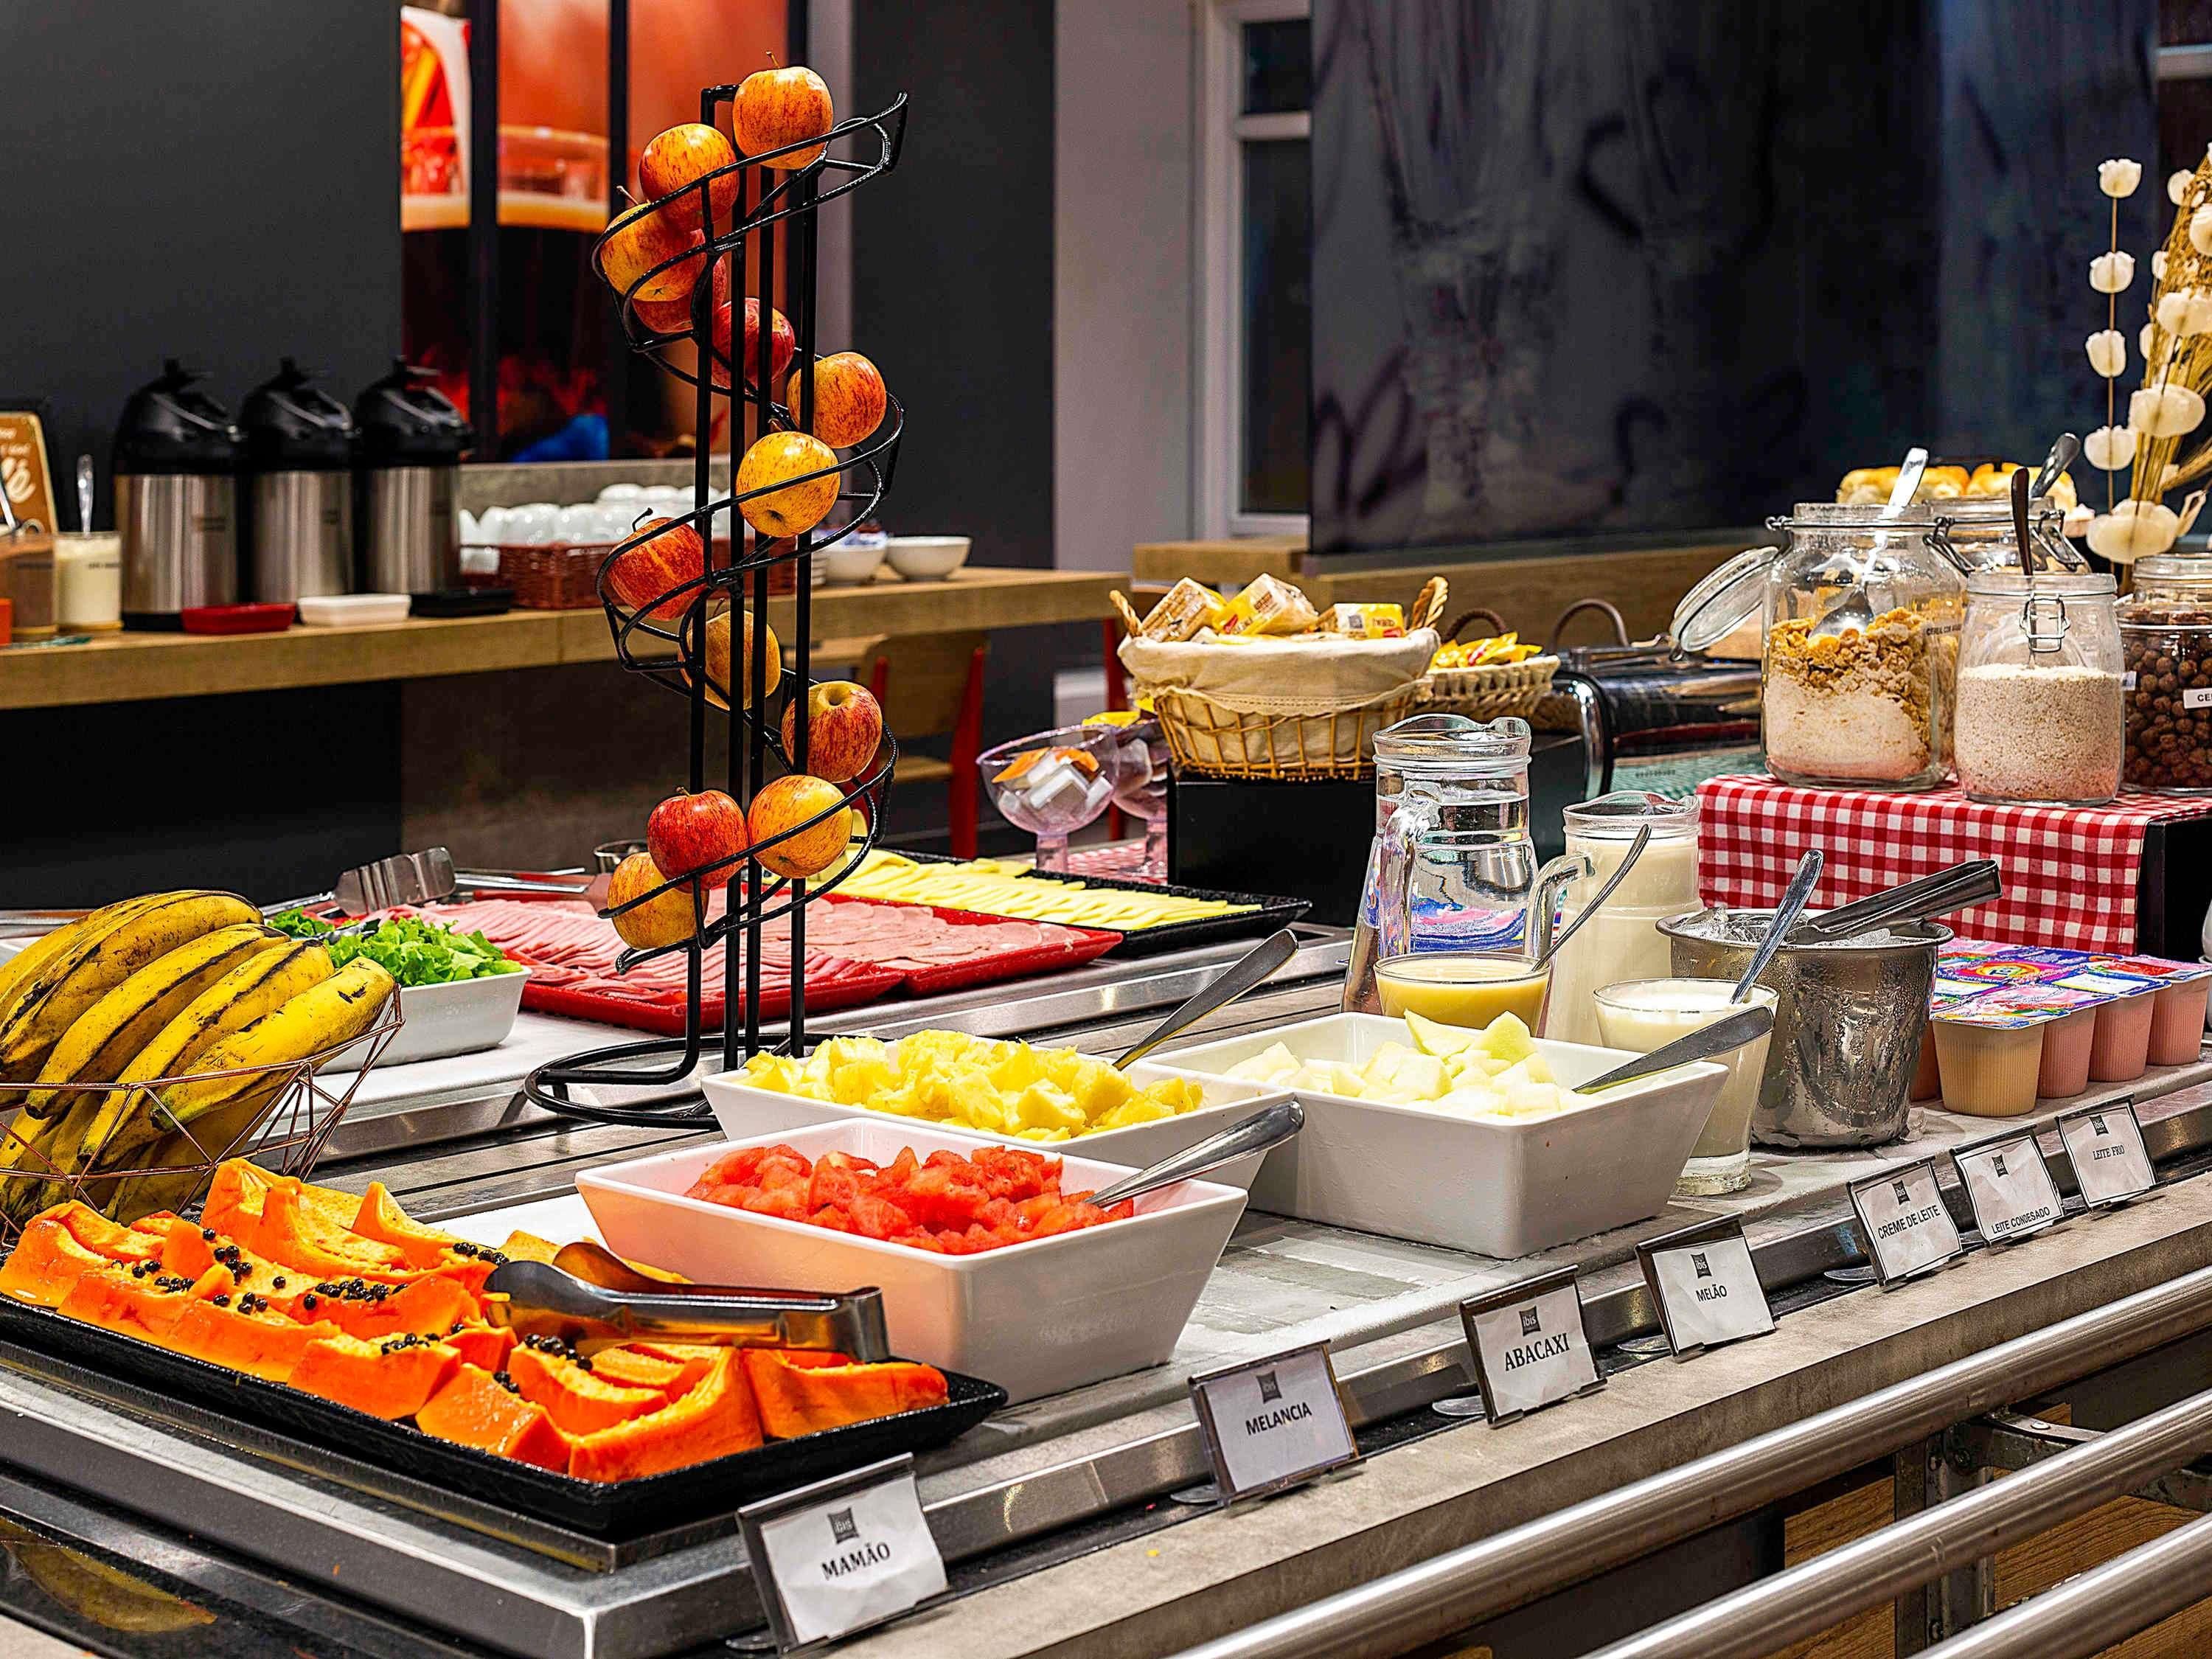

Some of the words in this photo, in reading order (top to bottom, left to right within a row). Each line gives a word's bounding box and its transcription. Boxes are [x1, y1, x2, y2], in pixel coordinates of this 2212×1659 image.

[2197, 693, 2212, 702] CE
[2093, 1147, 2111, 1161] LEITE
[2111, 1144, 2125, 1156] FRIO
[1877, 1218, 1907, 1239] CREME
[1905, 1213, 1919, 1228] DE
[1917, 1204, 1941, 1223] LEITE
[1991, 1220, 2010, 1234] LEITE
[2011, 1206, 2051, 1228] CONDESADO
[1694, 1259, 1708, 1270] ibis
[1695, 1284, 1728, 1303] MELÃO
[1522, 1313, 1537, 1327] ibis
[1504, 1332, 1571, 1371] ABACAXI
[1245, 1402, 1312, 1436] MELANCIA
[821, 1542, 891, 1580] MAMÃO
